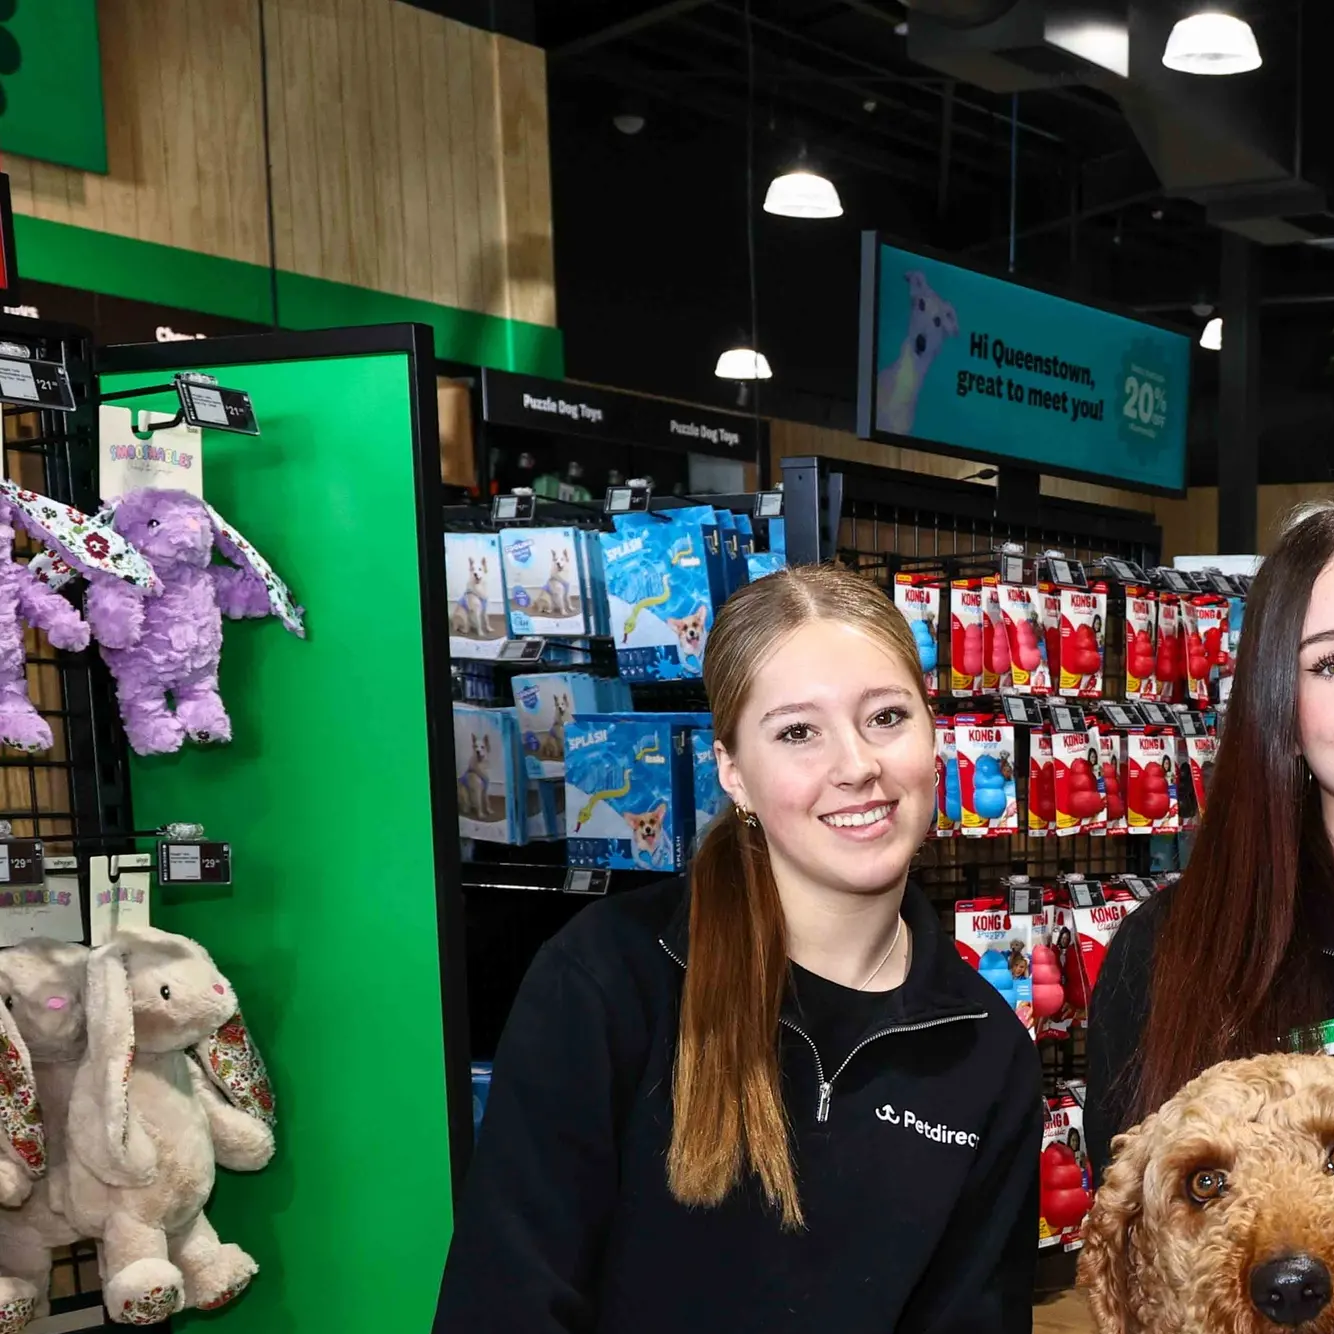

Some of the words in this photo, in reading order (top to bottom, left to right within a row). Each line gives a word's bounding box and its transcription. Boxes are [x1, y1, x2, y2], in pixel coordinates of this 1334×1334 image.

[970, 332, 988, 359] Hi
[992, 339, 1096, 391] Queenstown,
[957, 370, 1003, 398] great
[1007, 378, 1024, 403] to
[1028, 387, 1068, 413] meet
[1072, 399, 1104, 422] you!
[523, 393, 557, 413] Puzzle
[559, 401, 579, 420] Dog
[580, 403, 603, 422] Toys
[670, 420, 699, 437] Puzzle
[701, 425, 718, 443] Dog
[719, 429, 739, 446] Toys
[905, 589, 925, 603] KONG
[1007, 588, 1025, 602] KONG
[1070, 594, 1091, 608] KONG
[568, 729, 608, 751] SPLASH
[968, 729, 994, 742] KONG
[1063, 733, 1084, 748] KONG
[1139, 738, 1159, 750] KONG
[1090, 905, 1120, 924] KONG
[973, 915, 1001, 931] KONG
